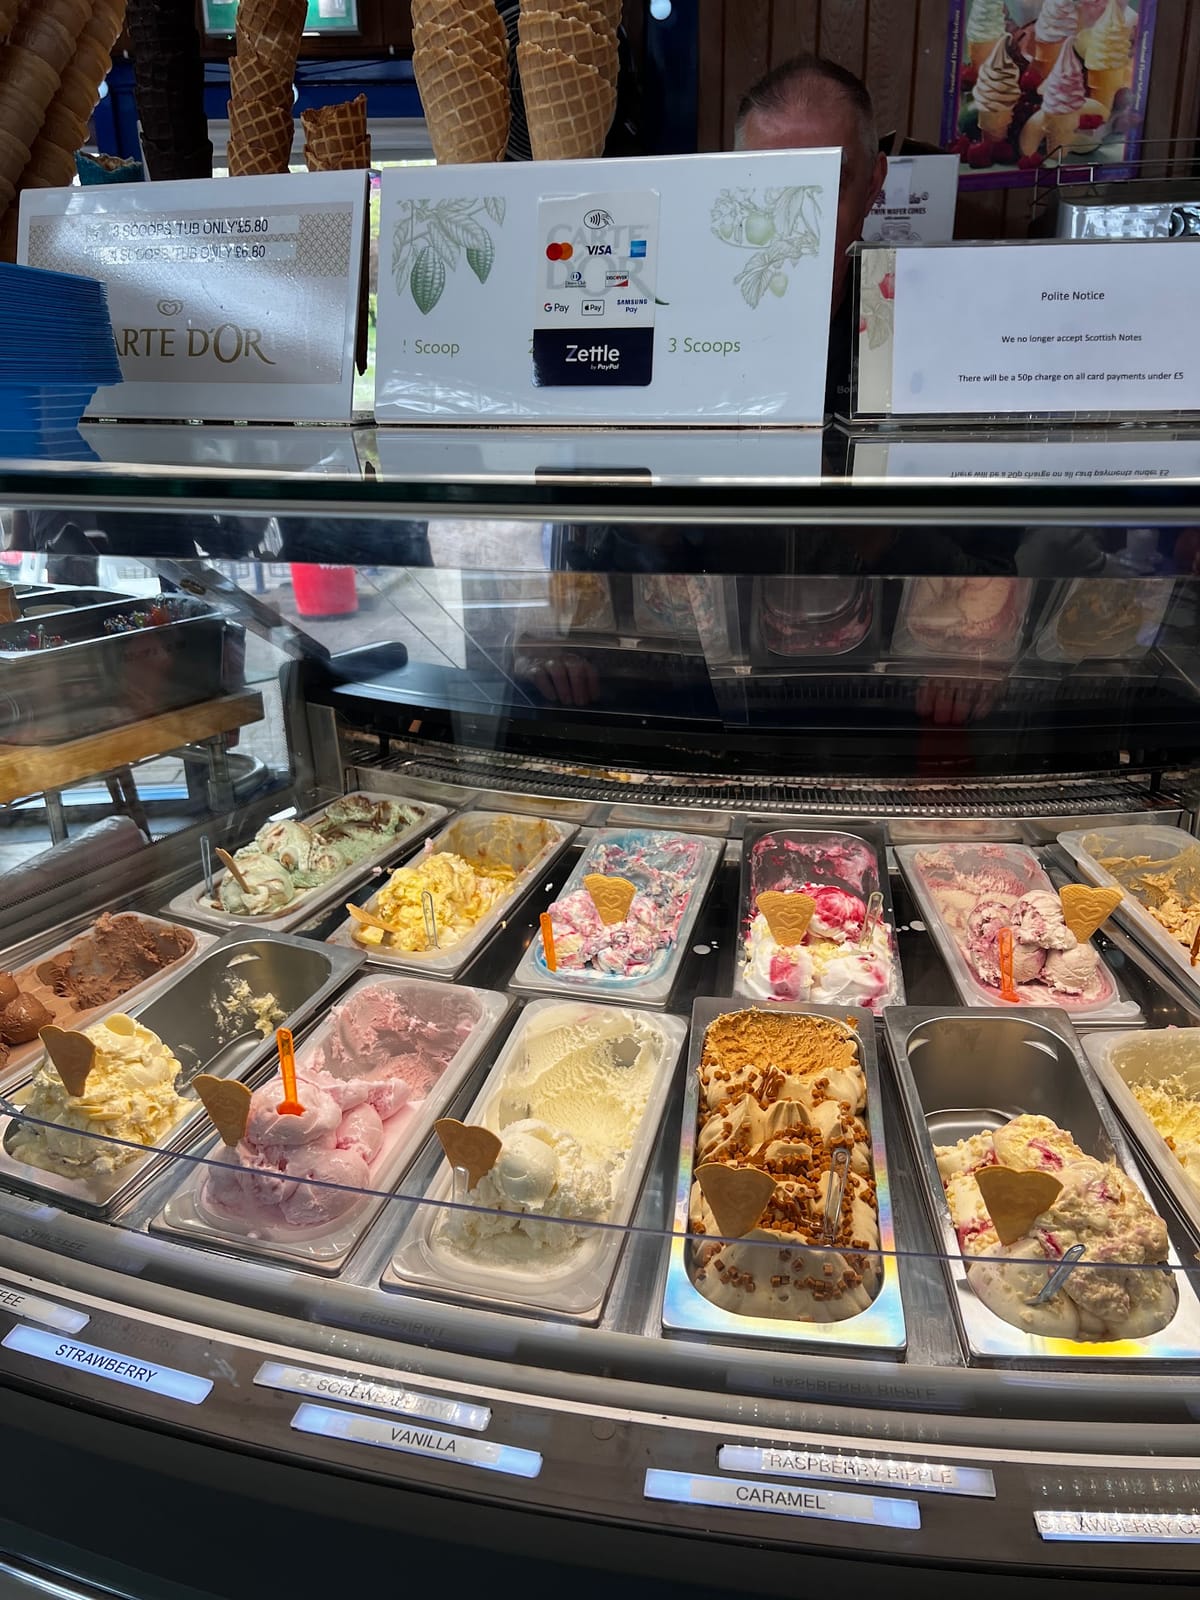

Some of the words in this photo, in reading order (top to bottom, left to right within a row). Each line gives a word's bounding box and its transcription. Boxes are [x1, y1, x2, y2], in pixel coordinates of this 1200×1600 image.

[176, 221, 200, 235] TUB
[238, 219, 268, 233] £5.80
[235, 245, 266, 258] £6.80
[586, 245, 613, 256] VISA
[1041, 292, 1070, 301] Polite
[1073, 291, 1105, 300] Notice
[554, 303, 570, 314] Pay
[625, 306, 638, 315] Pay
[668, 338, 677, 352] 3
[683, 338, 741, 356] Scoops
[1001, 335, 1016, 343] We
[1029, 334, 1055, 345] longer
[1056, 335, 1083, 344] accept
[1085, 333, 1117, 342] Scottish
[1119, 333, 1142, 342] Notes
[415, 340, 460, 357] Scoop
[565, 345, 620, 362] Zettle
[958, 374, 981, 382] There
[983, 373, 997, 382] will
[999, 373, 1009, 382] be
[1017, 373, 1033, 384] 50p
[1035, 373, 1062, 384] charge
[1075, 372, 1086, 381] all
[1087, 372, 1105, 381] card
[1106, 373, 1146, 383] payments
[1147, 371, 1172, 380] under
[1174, 371, 1184, 380] £5
[0, 1289, 25, 1307] FEE
[55, 1344, 158, 1383] STRAWBERRY
[391, 1427, 456, 1453] VANILLA
[770, 1454, 881, 1477] RASPBERRY
[887, 1469, 953, 1484] RIPPLE
[736, 1486, 826, 1510] CARAMEL
